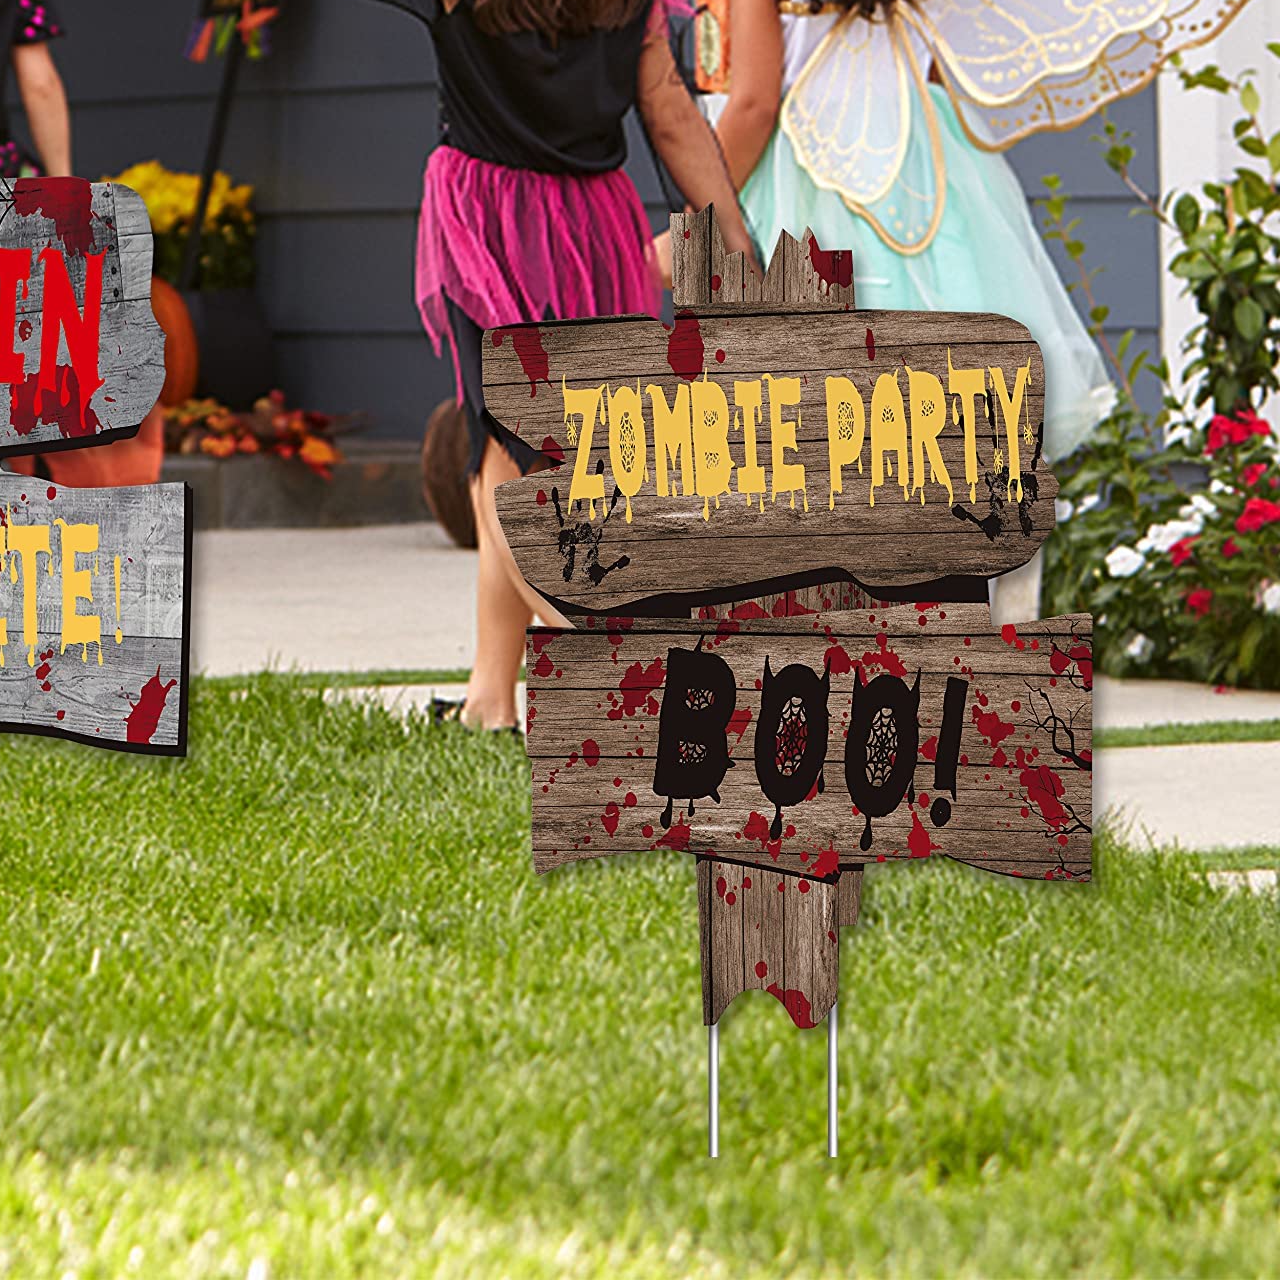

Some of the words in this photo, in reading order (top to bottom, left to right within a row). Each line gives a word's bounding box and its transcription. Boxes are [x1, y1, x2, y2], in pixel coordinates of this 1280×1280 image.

[562, 368, 809, 523] ZOMBIE
[824, 348, 1032, 510] PARTY
[652, 635, 969, 851] BOO!
